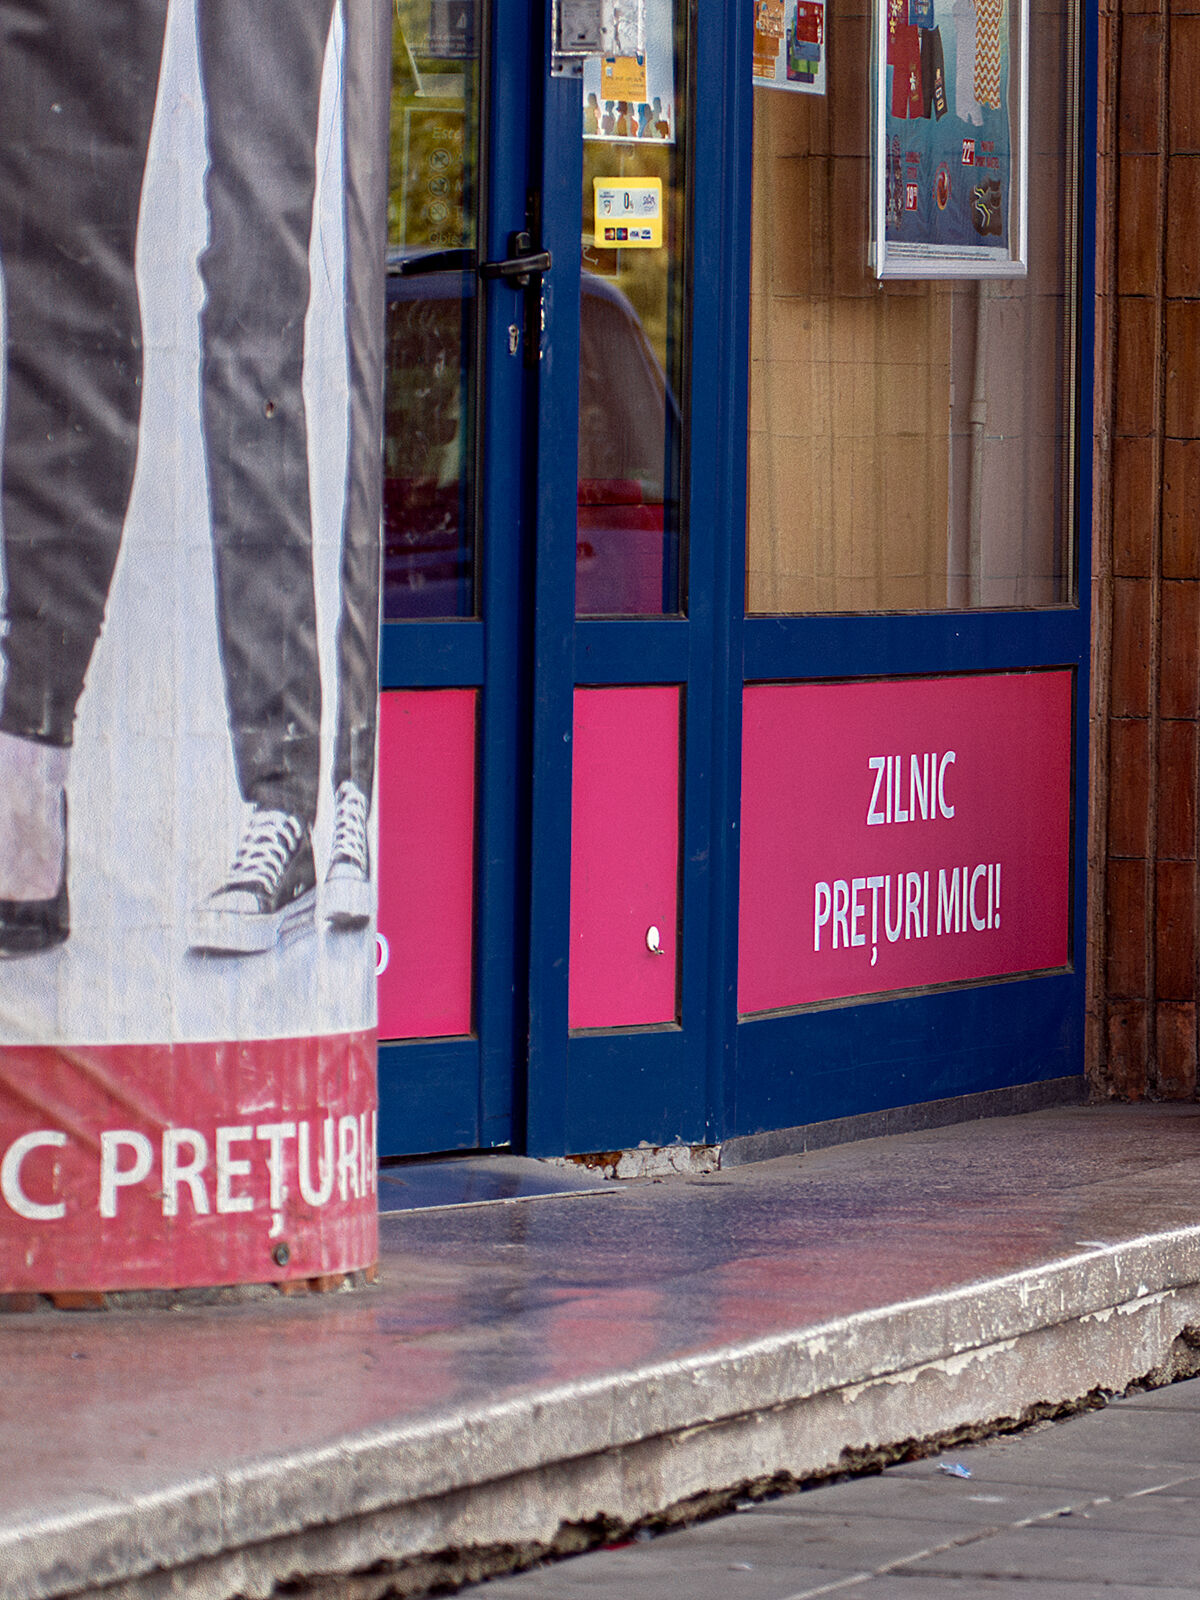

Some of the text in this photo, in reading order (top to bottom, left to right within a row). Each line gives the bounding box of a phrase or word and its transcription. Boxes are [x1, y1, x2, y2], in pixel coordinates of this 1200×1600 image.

[866, 750, 956, 826] ZILNIC
[813, 862, 1001, 967] PREȚURI MICI!
